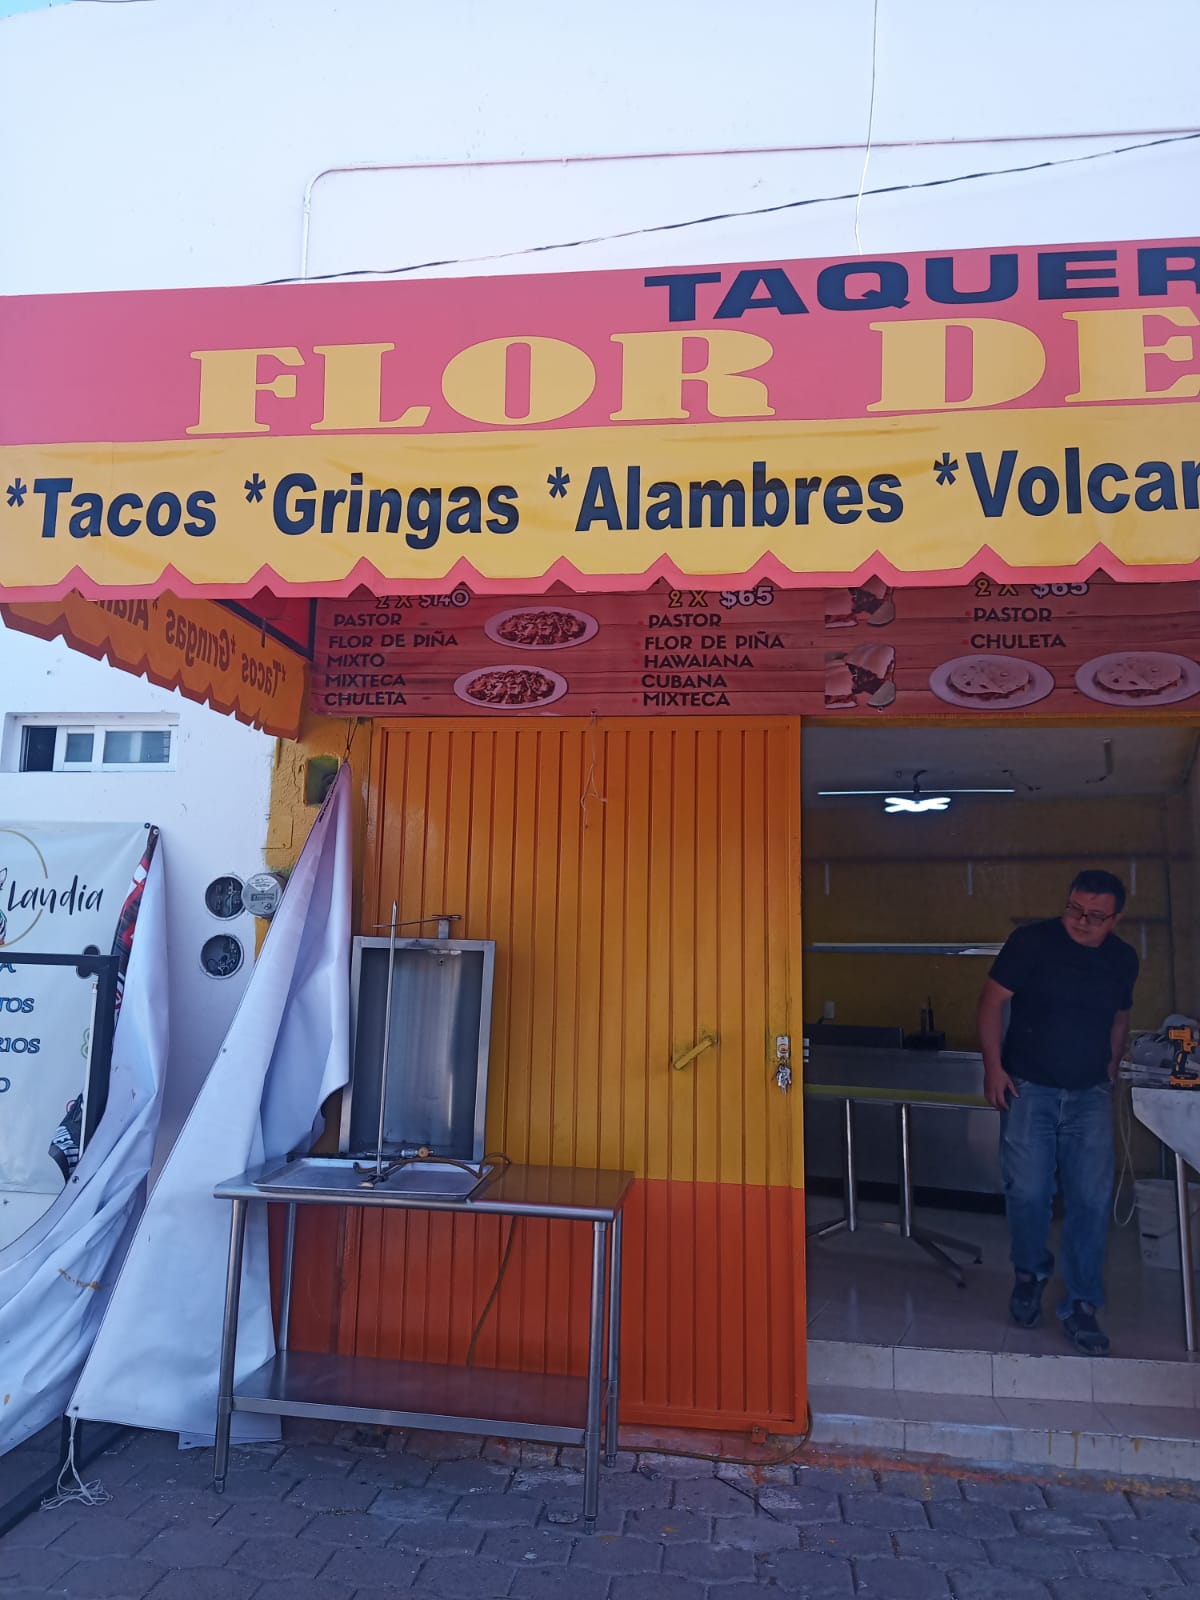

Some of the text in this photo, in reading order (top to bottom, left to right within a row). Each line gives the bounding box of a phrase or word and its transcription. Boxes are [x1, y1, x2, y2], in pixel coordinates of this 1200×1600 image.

[644, 247, 1200, 323] TAQUER
[186, 305, 1200, 435] FLOR DE
[975, 578, 992, 597] 2
[668, 586, 774, 609] 2 X $65
[333, 613, 403, 627] PASTOR
[648, 613, 722, 628] PASTOR
[973, 607, 1052, 622] PASTOR
[328, 630, 458, 649] FLOR DE PIÑA
[644, 631, 785, 651] FLOR DE PIÑA
[970, 634, 1067, 650] CHULETA
[326, 653, 386, 668] MIXTO
[643, 654, 754, 669] HAWAIANA
[325, 674, 406, 688] MIXTECA
[641, 674, 728, 689] CUBANA
[324, 691, 407, 707] CHULETA
[643, 692, 731, 707] MIXTECA
[7, 874, 104, 916] Landia
